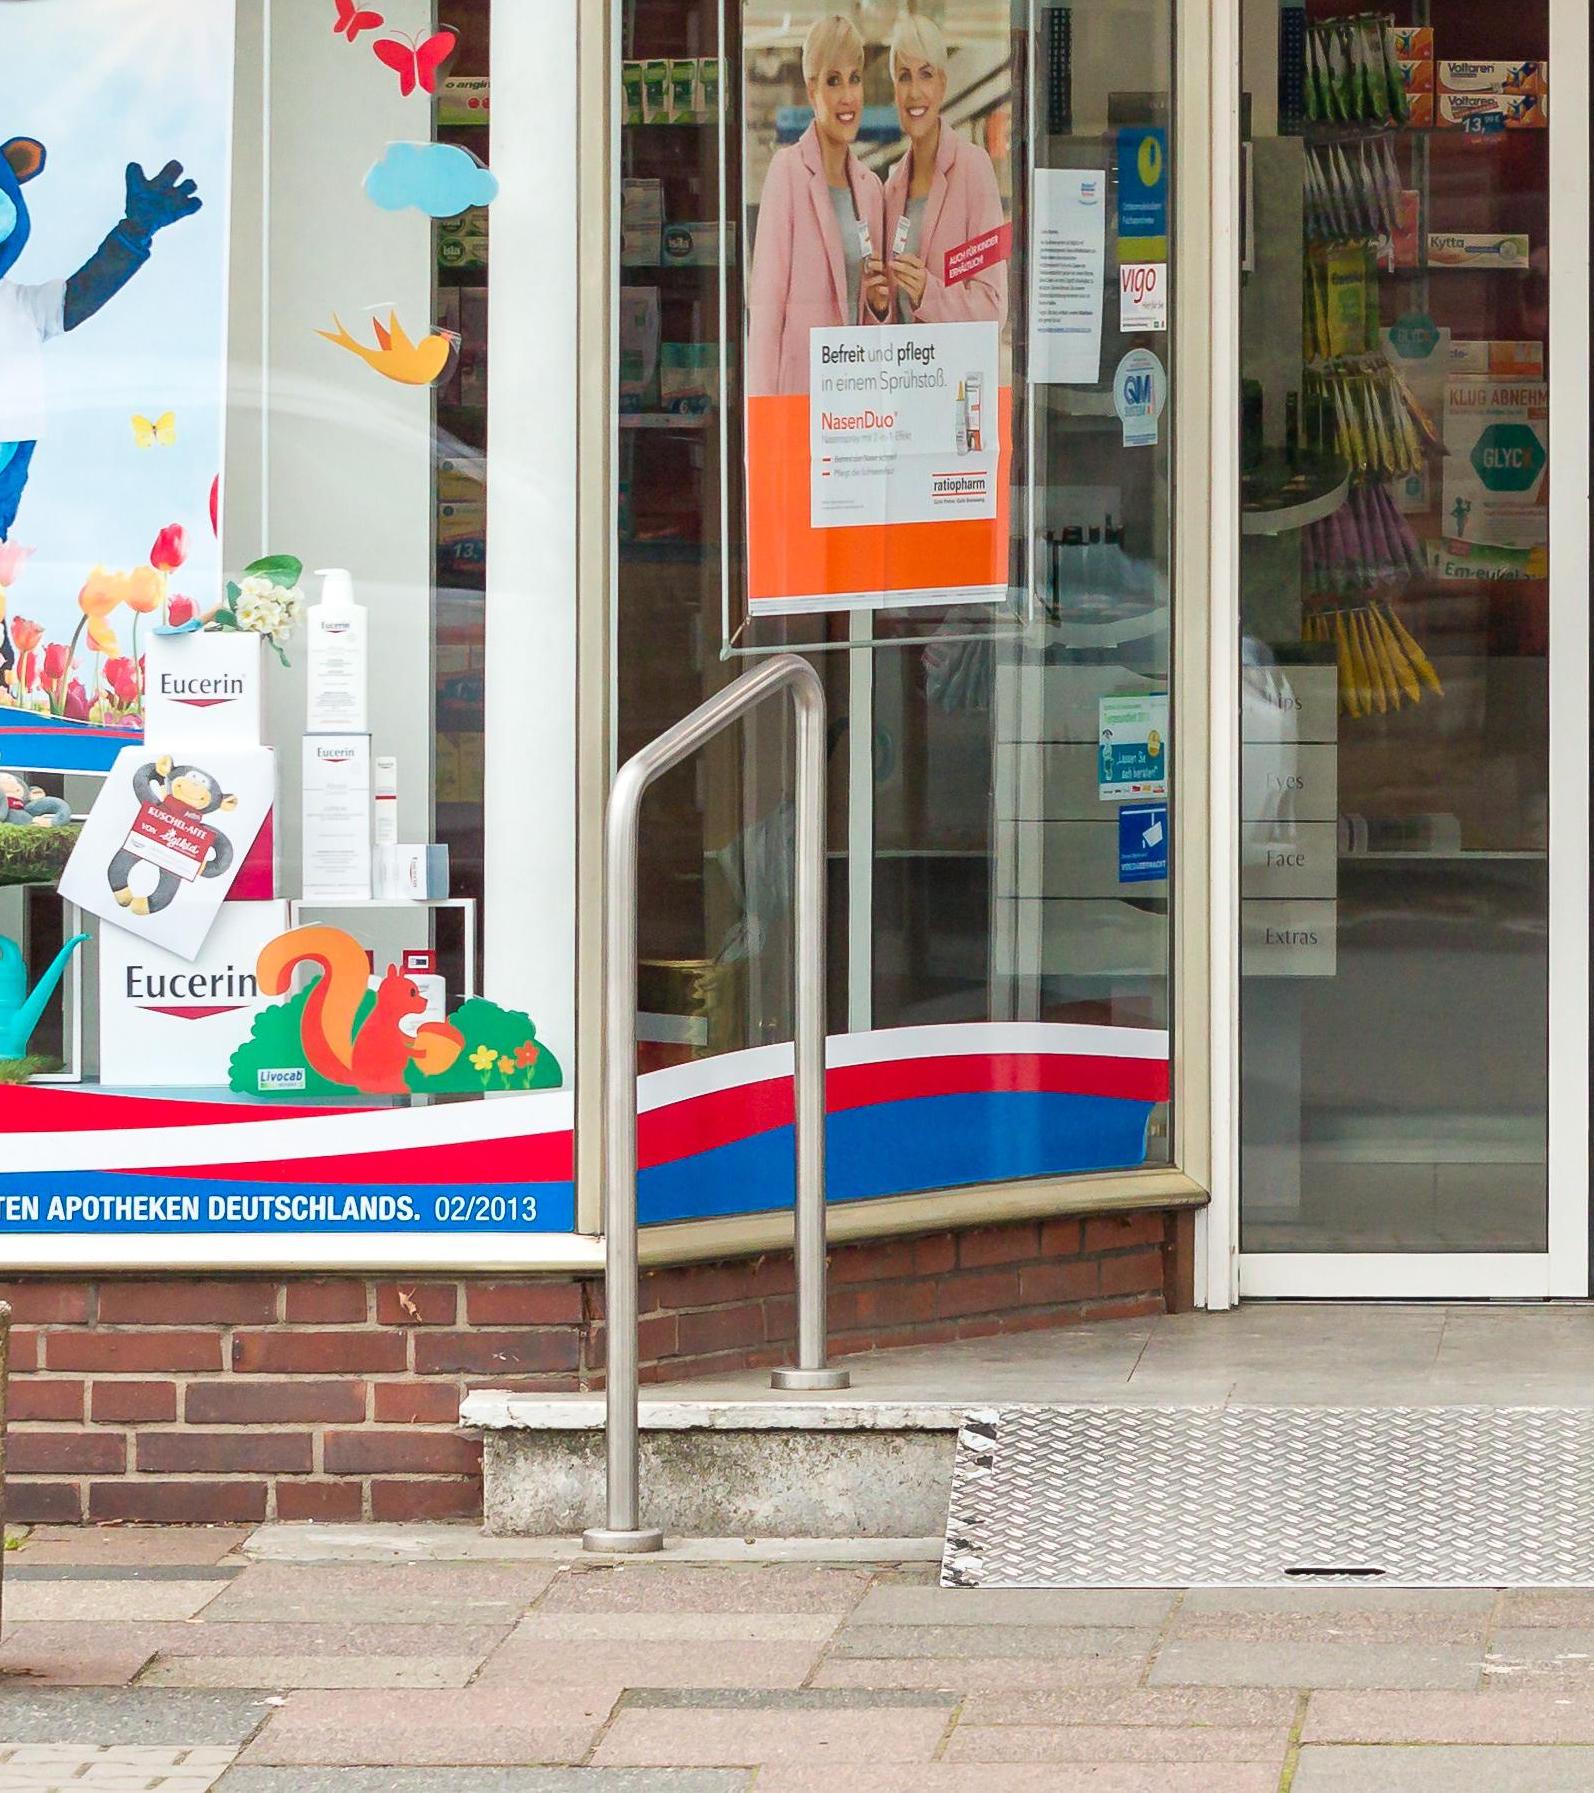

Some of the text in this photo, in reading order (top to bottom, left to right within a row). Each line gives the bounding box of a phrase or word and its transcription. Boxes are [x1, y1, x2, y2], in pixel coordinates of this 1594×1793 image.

[1447, 62, 1495, 74] Voltaren
[1430, 236, 1465, 251] Kytta
[821, 341, 935, 367] Befreit und pflegt
[821, 367, 948, 395] in einem Sprühstoß.
[1449, 386, 1487, 406] KLUG
[933, 477, 986, 494] ratiopharm
[320, 620, 351, 630] Eucerin
[160, 672, 244, 695] Eucerin
[316, 746, 355, 758] Eucerin
[1266, 850, 1306, 868] Face
[1266, 927, 1318, 946] Extras
[125, 965, 259, 1000] Eucerin
[47, 1195, 200, 1222] APOTHEKEN
[207, 1195, 420, 1222] DEUTSCHLANDS.
[434, 1195, 538, 1223] 02/2013
